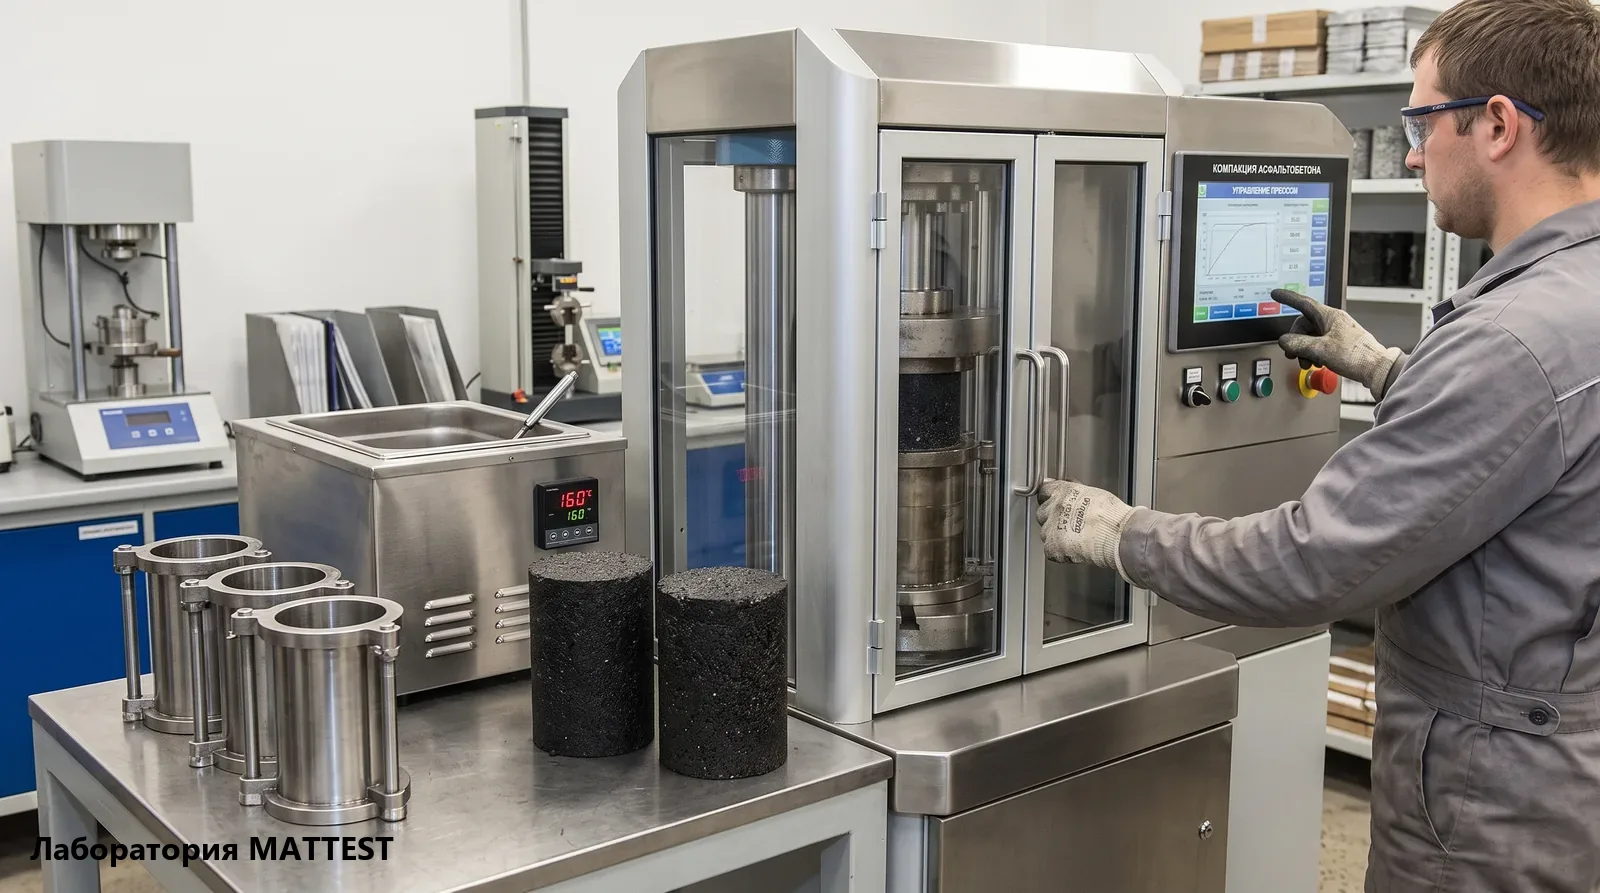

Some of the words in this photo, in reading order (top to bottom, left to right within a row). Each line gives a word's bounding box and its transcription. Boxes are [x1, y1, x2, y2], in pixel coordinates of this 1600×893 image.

[1212, 163, 1257, 175] КОМПАКЦИЯ
[1258, 164, 1322, 175] АСФАЛЬТОБЕТОНА
[567, 508, 585, 521] 160
